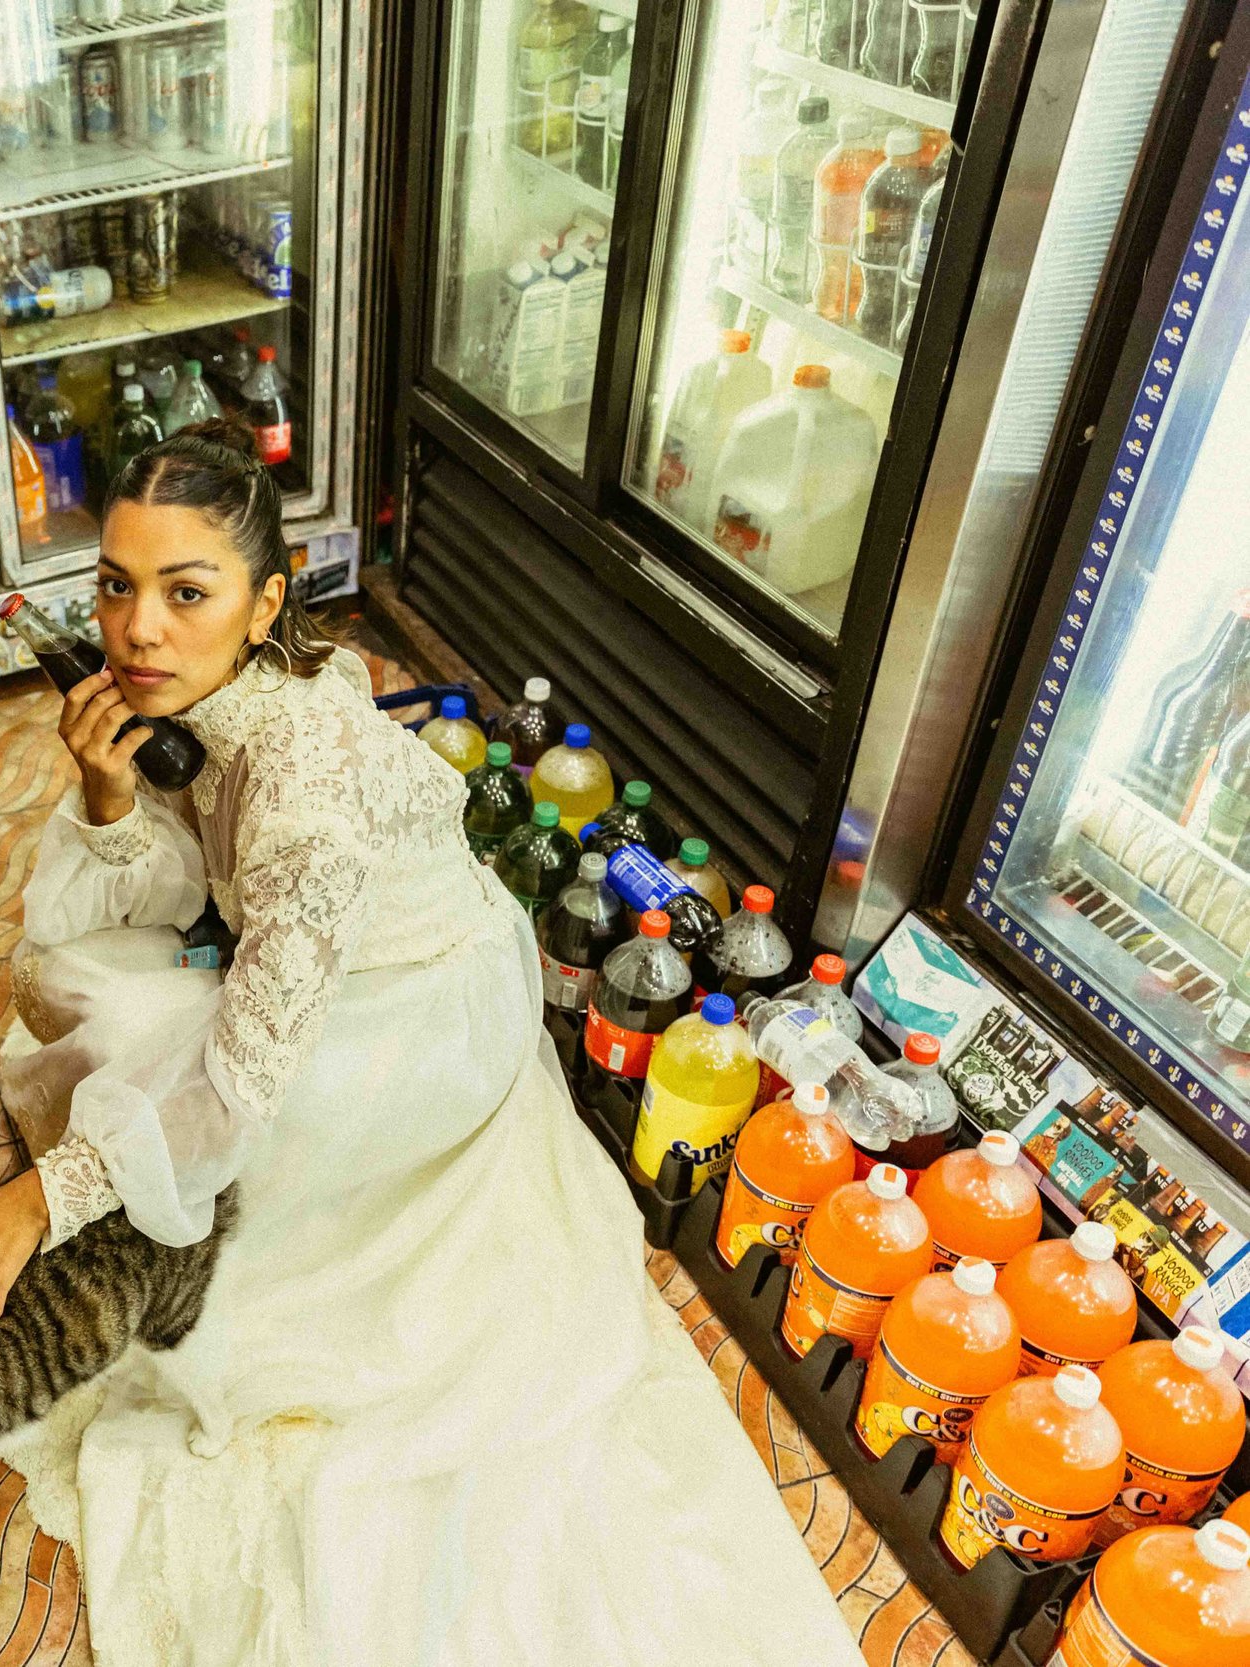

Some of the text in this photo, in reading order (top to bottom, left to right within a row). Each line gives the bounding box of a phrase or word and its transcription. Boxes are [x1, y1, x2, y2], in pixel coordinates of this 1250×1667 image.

[973, 1034, 1047, 1102] Dogfish Head
[1065, 1149, 1096, 1182] RANGER
[1073, 1138, 1104, 1171] VOODOO
[1153, 1266, 1186, 1301] RANGER
[1163, 1254, 1196, 1290] VOODOO
[1151, 1283, 1171, 1308] IPA
